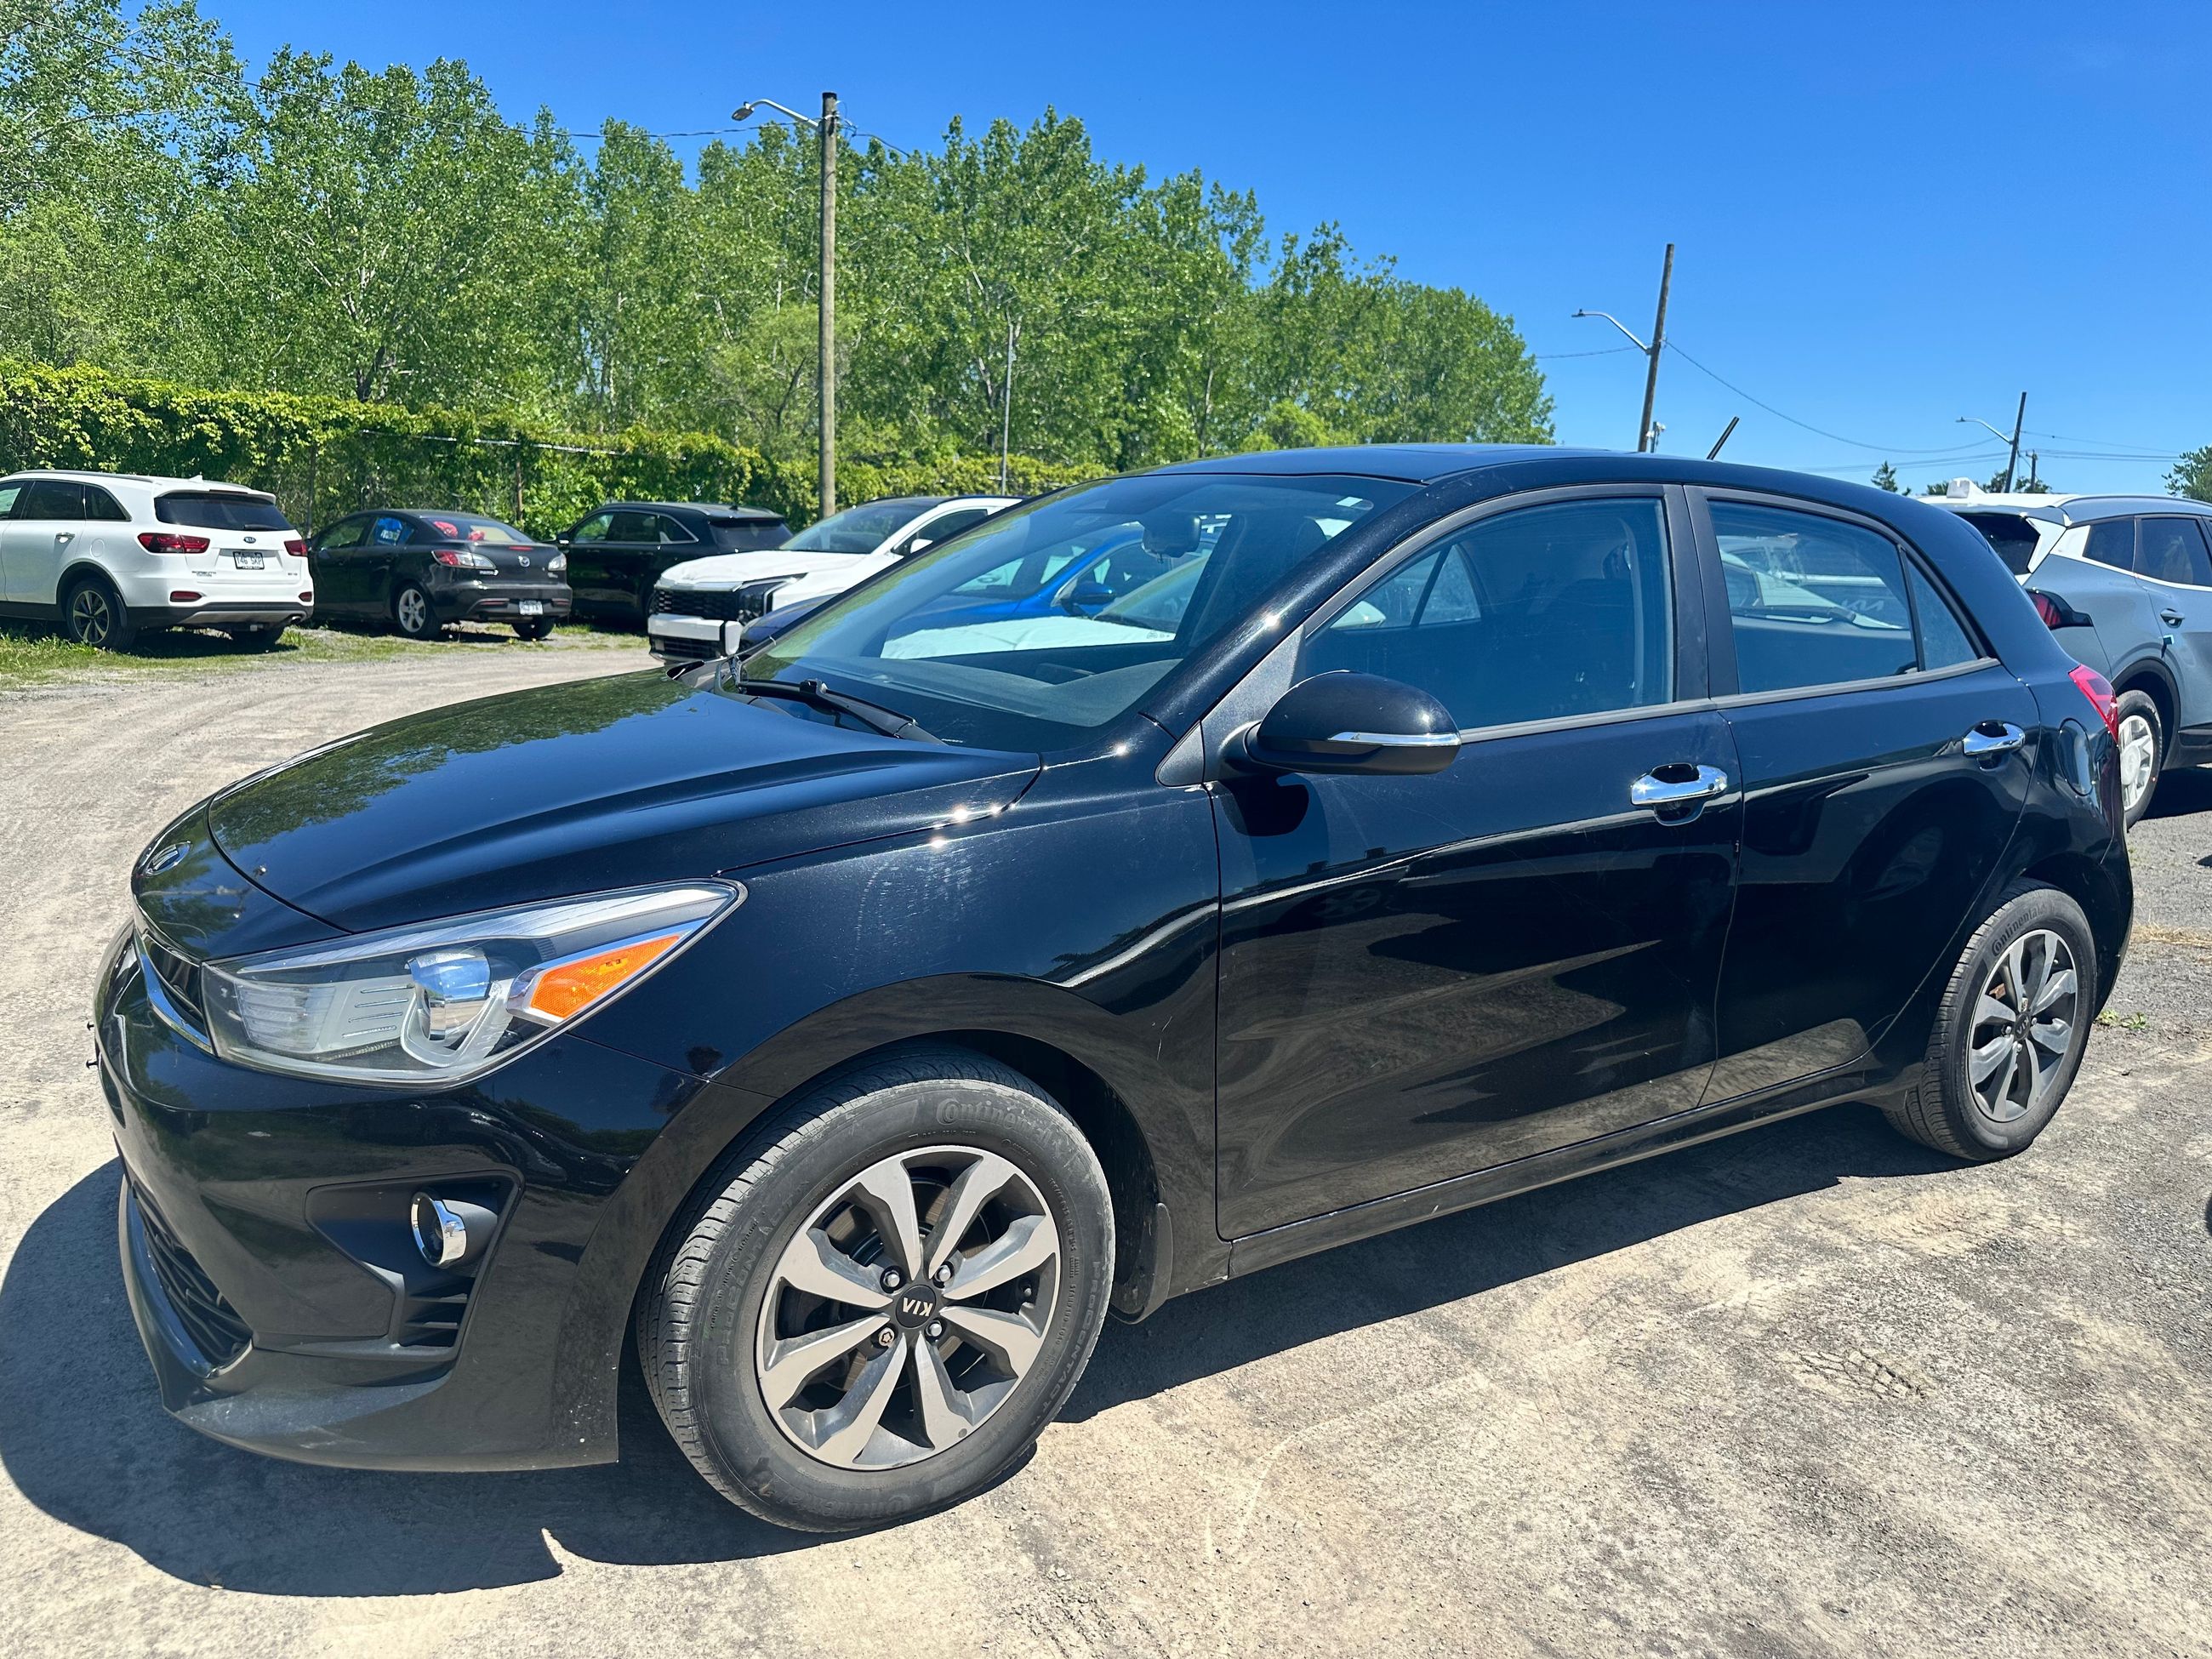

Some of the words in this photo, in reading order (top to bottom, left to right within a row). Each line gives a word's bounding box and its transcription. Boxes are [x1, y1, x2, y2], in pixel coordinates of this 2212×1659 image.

[1992, 904, 2044, 957] Continental
[2016, 1016, 2029, 1035] KIA
[903, 1297, 933, 1317] KIA
